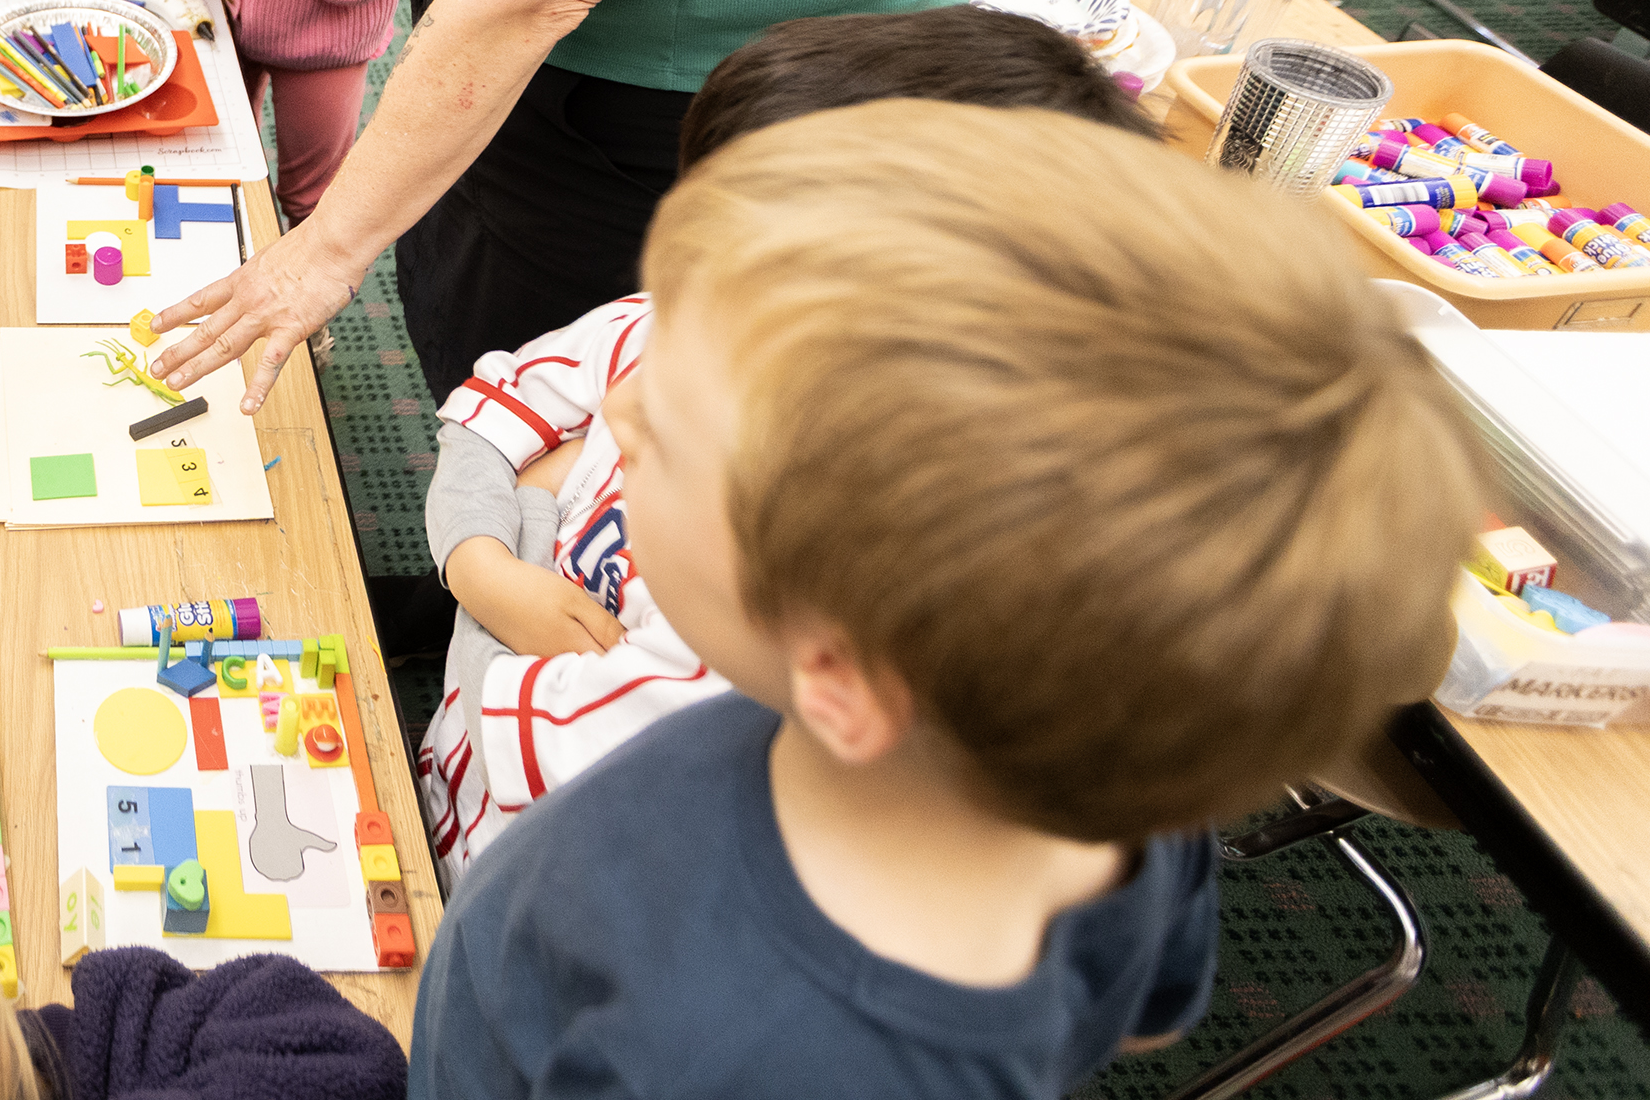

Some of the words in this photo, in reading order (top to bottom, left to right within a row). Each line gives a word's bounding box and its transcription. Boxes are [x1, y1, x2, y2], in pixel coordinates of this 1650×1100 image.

[157, 146, 222, 156] Scrapbook.com
[118, 800, 138, 814] 5
[121, 841, 141, 852] 1
